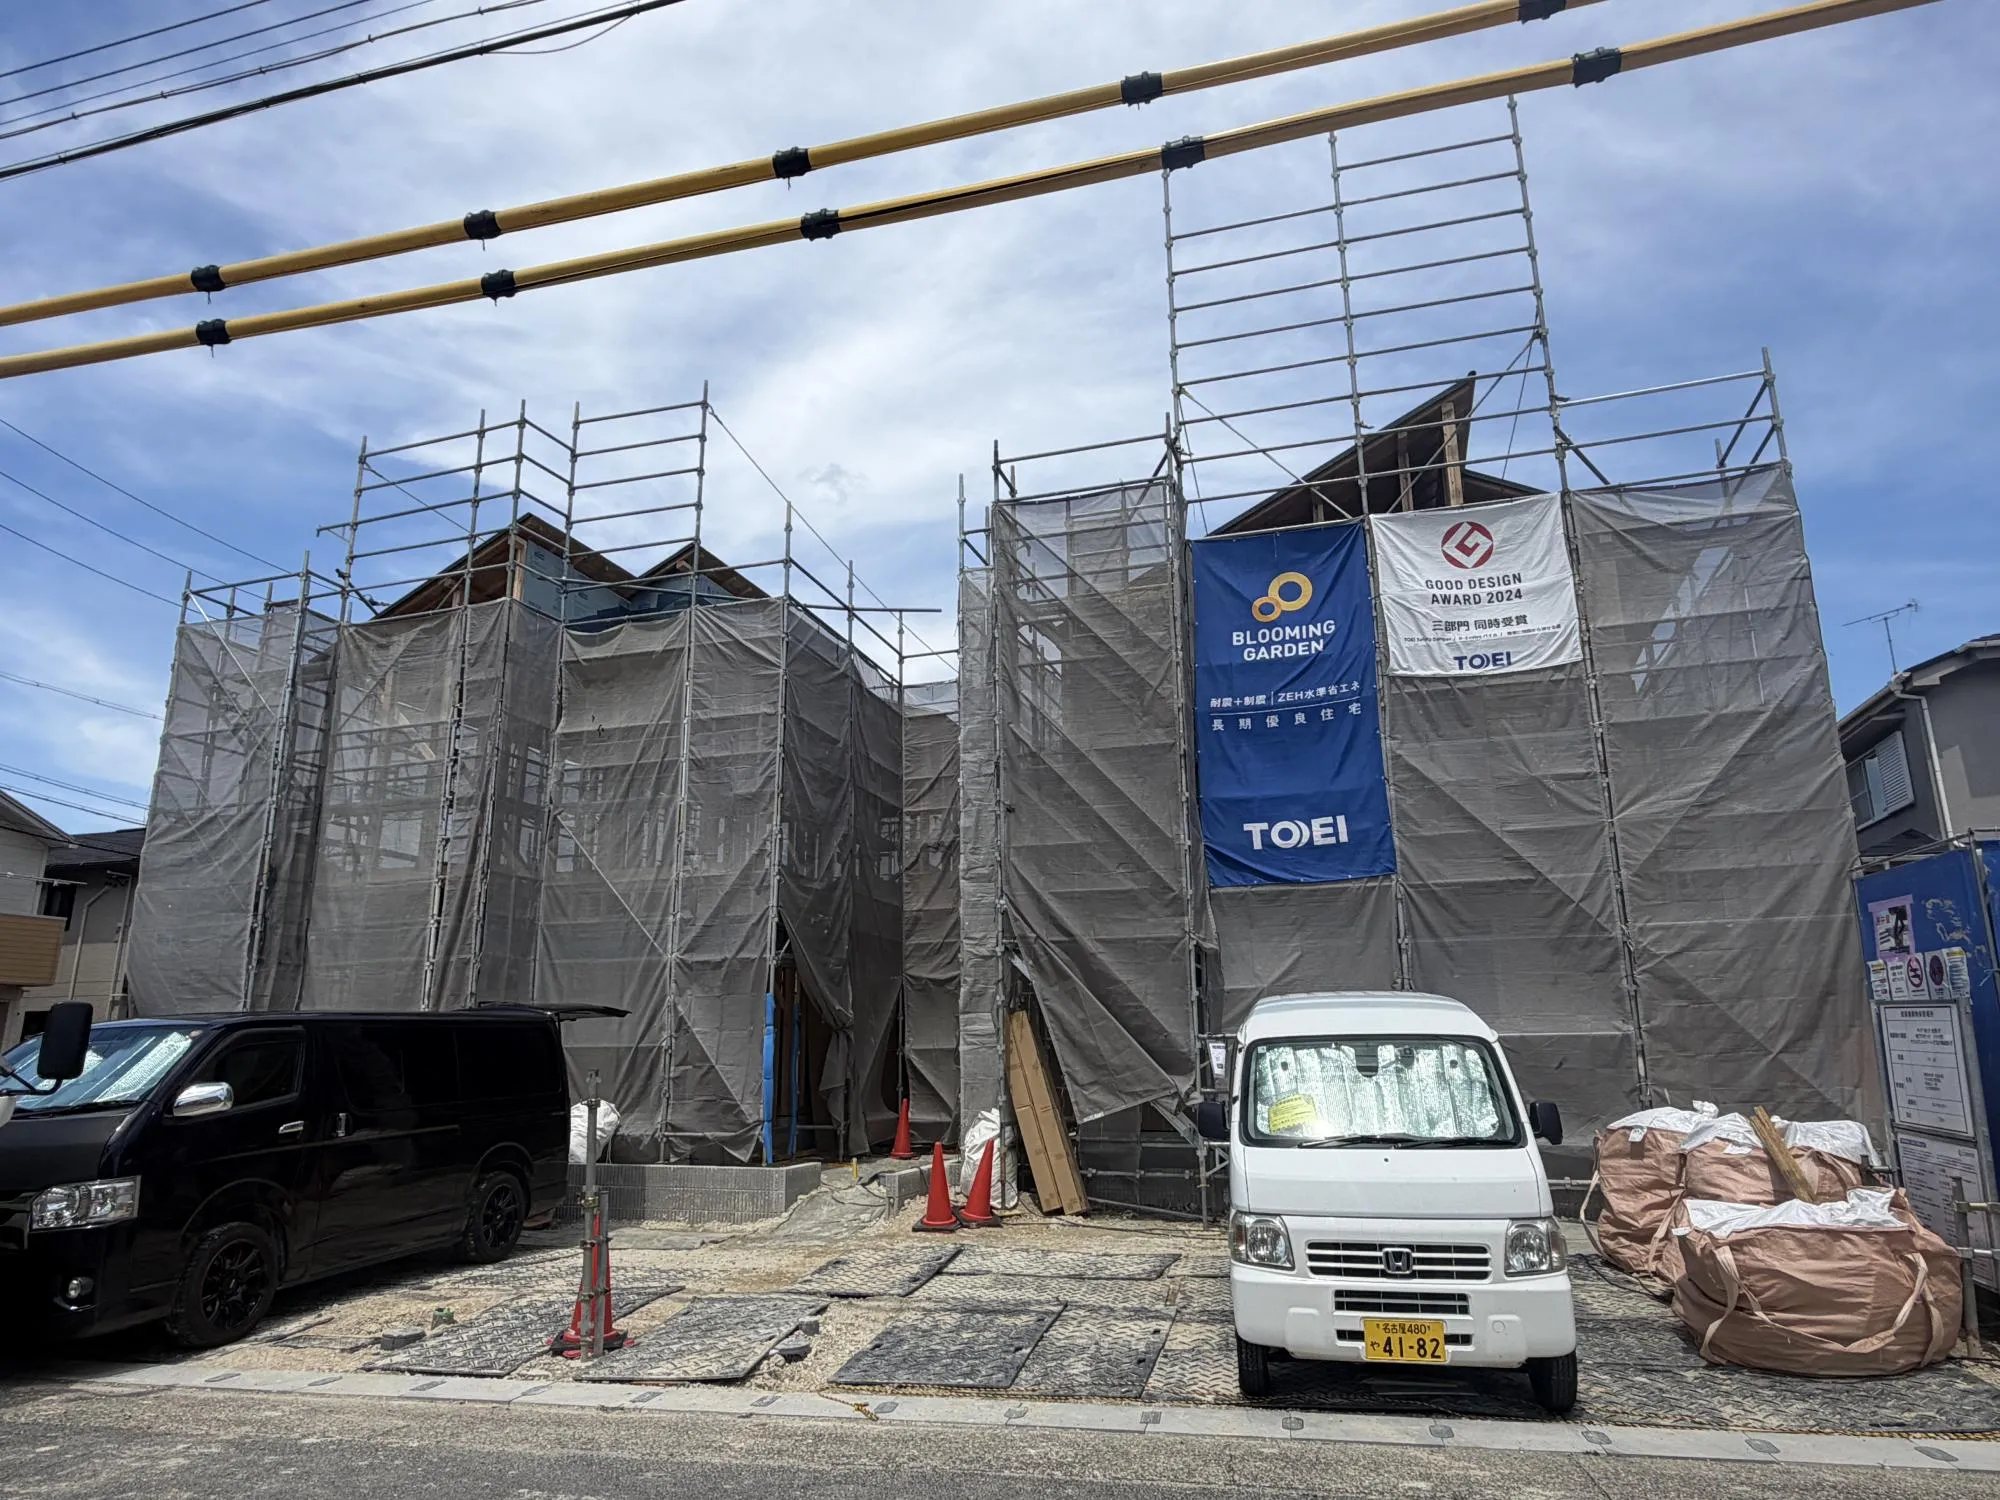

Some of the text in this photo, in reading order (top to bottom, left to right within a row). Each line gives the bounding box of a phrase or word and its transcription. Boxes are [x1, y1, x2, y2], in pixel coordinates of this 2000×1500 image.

[1425, 573, 1522, 591] GOOD DESIGN
[1431, 588, 1523, 605] AWARD 2024
[1232, 619, 1336, 646] BLOOMING
[1431, 614, 1528, 632] 三部門 同時受賞
[1243, 638, 1324, 661] GARDEN
[1453, 651, 1512, 670] TOEI
[1243, 814, 1348, 850] TOEI
[1370, 1336, 1442, 1359] や 41-82
